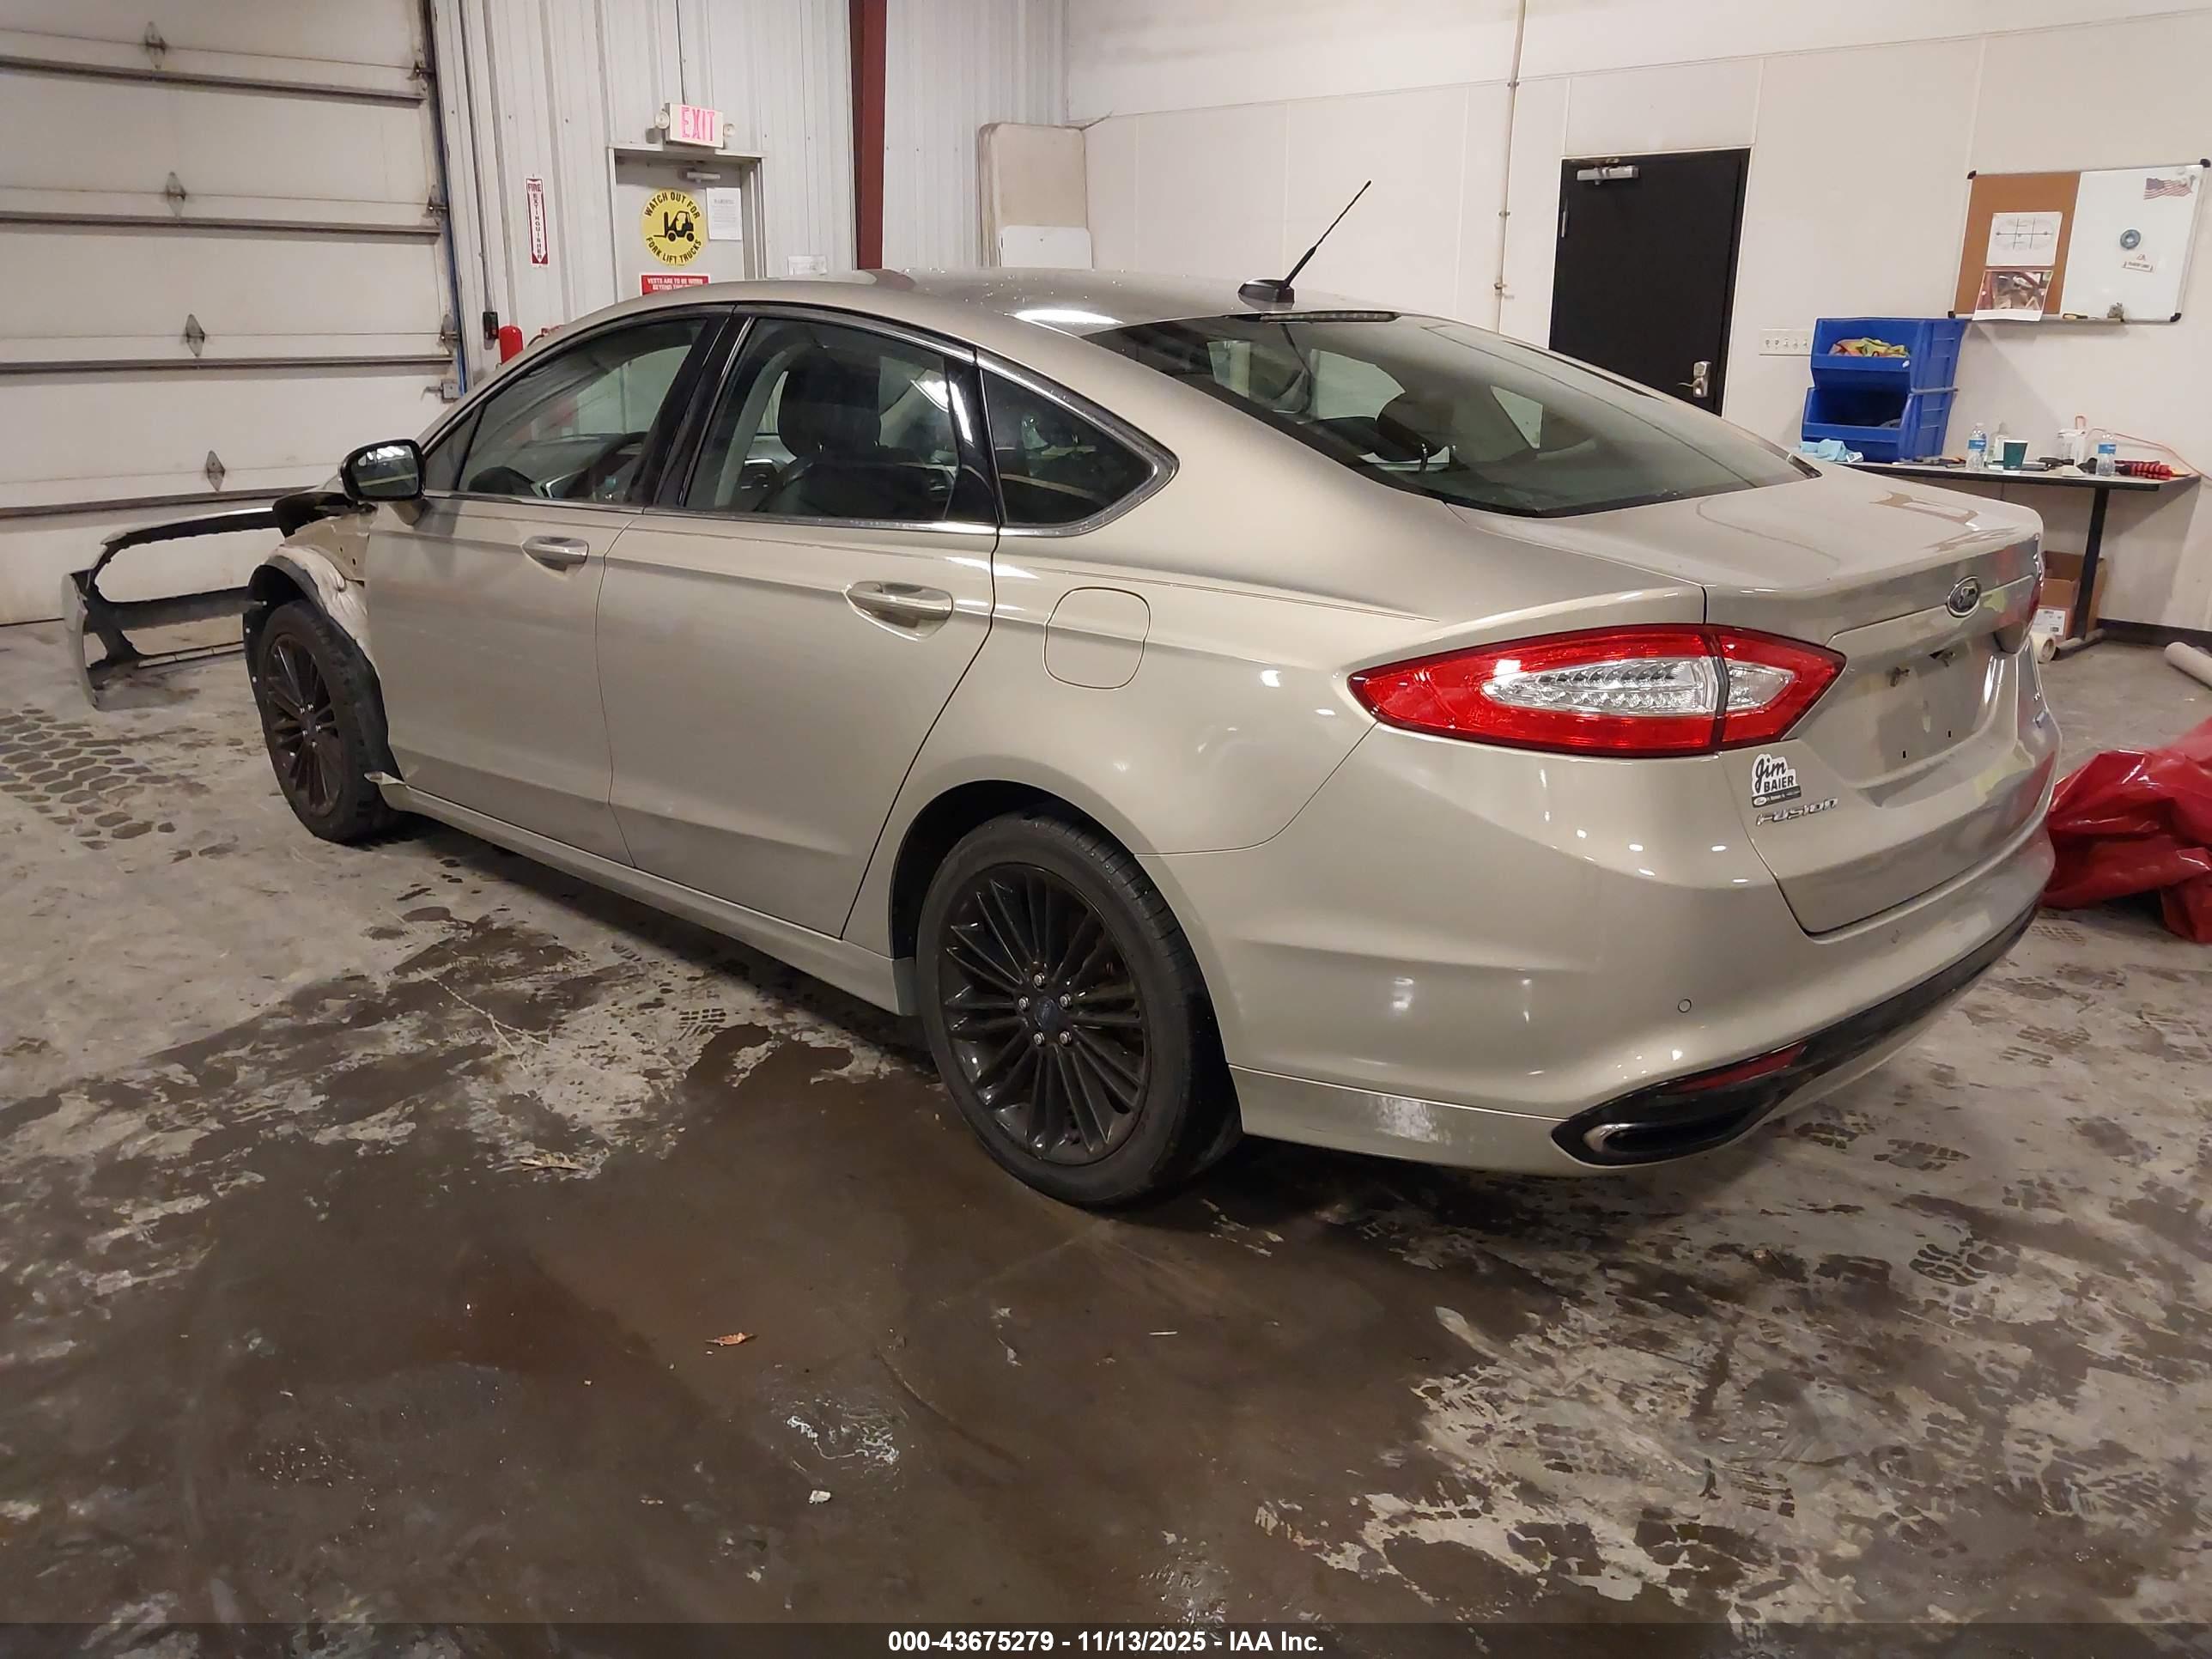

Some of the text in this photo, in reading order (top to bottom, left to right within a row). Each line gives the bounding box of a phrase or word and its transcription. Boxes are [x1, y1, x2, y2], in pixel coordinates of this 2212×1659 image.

[681, 106, 714, 141] EXIT
[527, 183, 541, 191] FIRE
[644, 191, 668, 216] WATCH
[670, 191, 686, 204] OUT
[686, 200, 701, 219] FOR
[532, 193, 542, 259] EXTINGUISHER
[646, 237, 702, 264] FORK LIFT TRUCKS
[1754, 757, 1786, 793] Jim
[1764, 775, 1794, 793] BAIER
